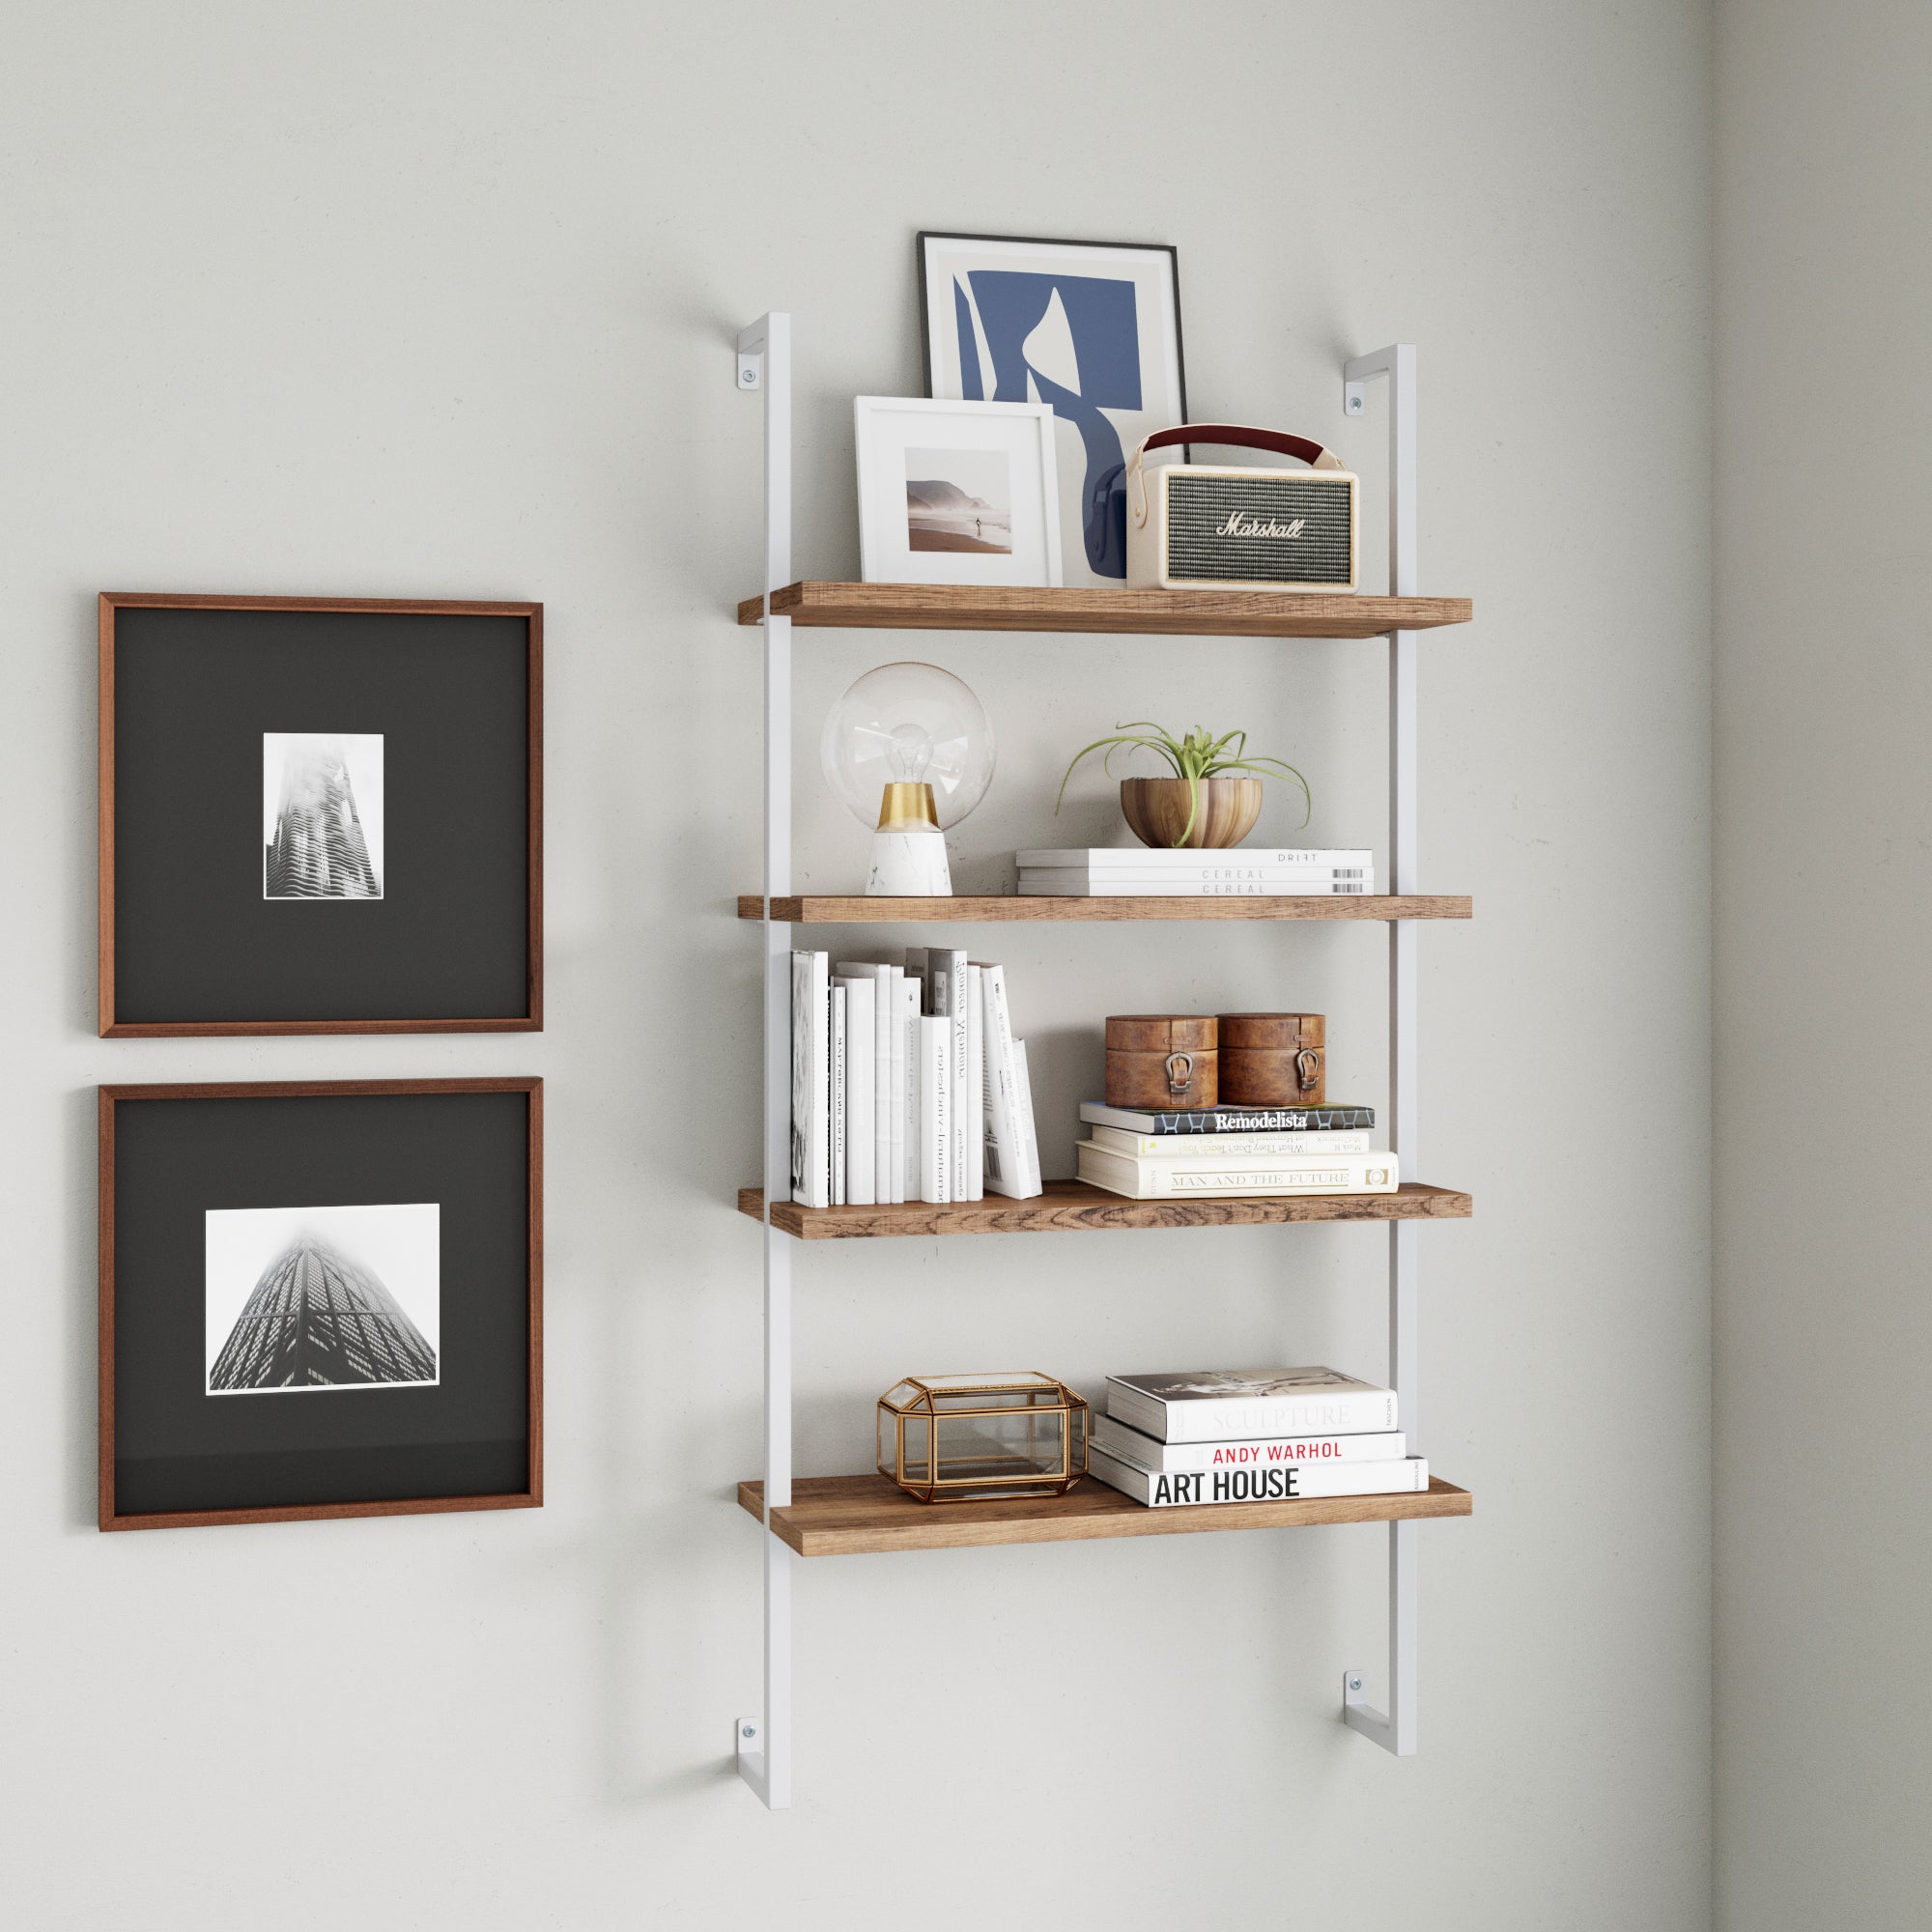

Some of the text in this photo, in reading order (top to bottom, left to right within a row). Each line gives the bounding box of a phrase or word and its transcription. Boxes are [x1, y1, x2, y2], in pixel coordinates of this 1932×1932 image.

[1215, 510, 1307, 538] Marshall
[1202, 868, 1265, 879] CEREAL
[1202, 884, 1265, 895] CEREAL
[1215, 1111, 1308, 1130] Remodelista
[1171, 1172, 1350, 1187] MAN AND THE FUTURE
[1212, 1446, 1261, 1464] ANDY
[1266, 1441, 1343, 1460] WARHOL
[1153, 1467, 1300, 1505] ART HOUSE
